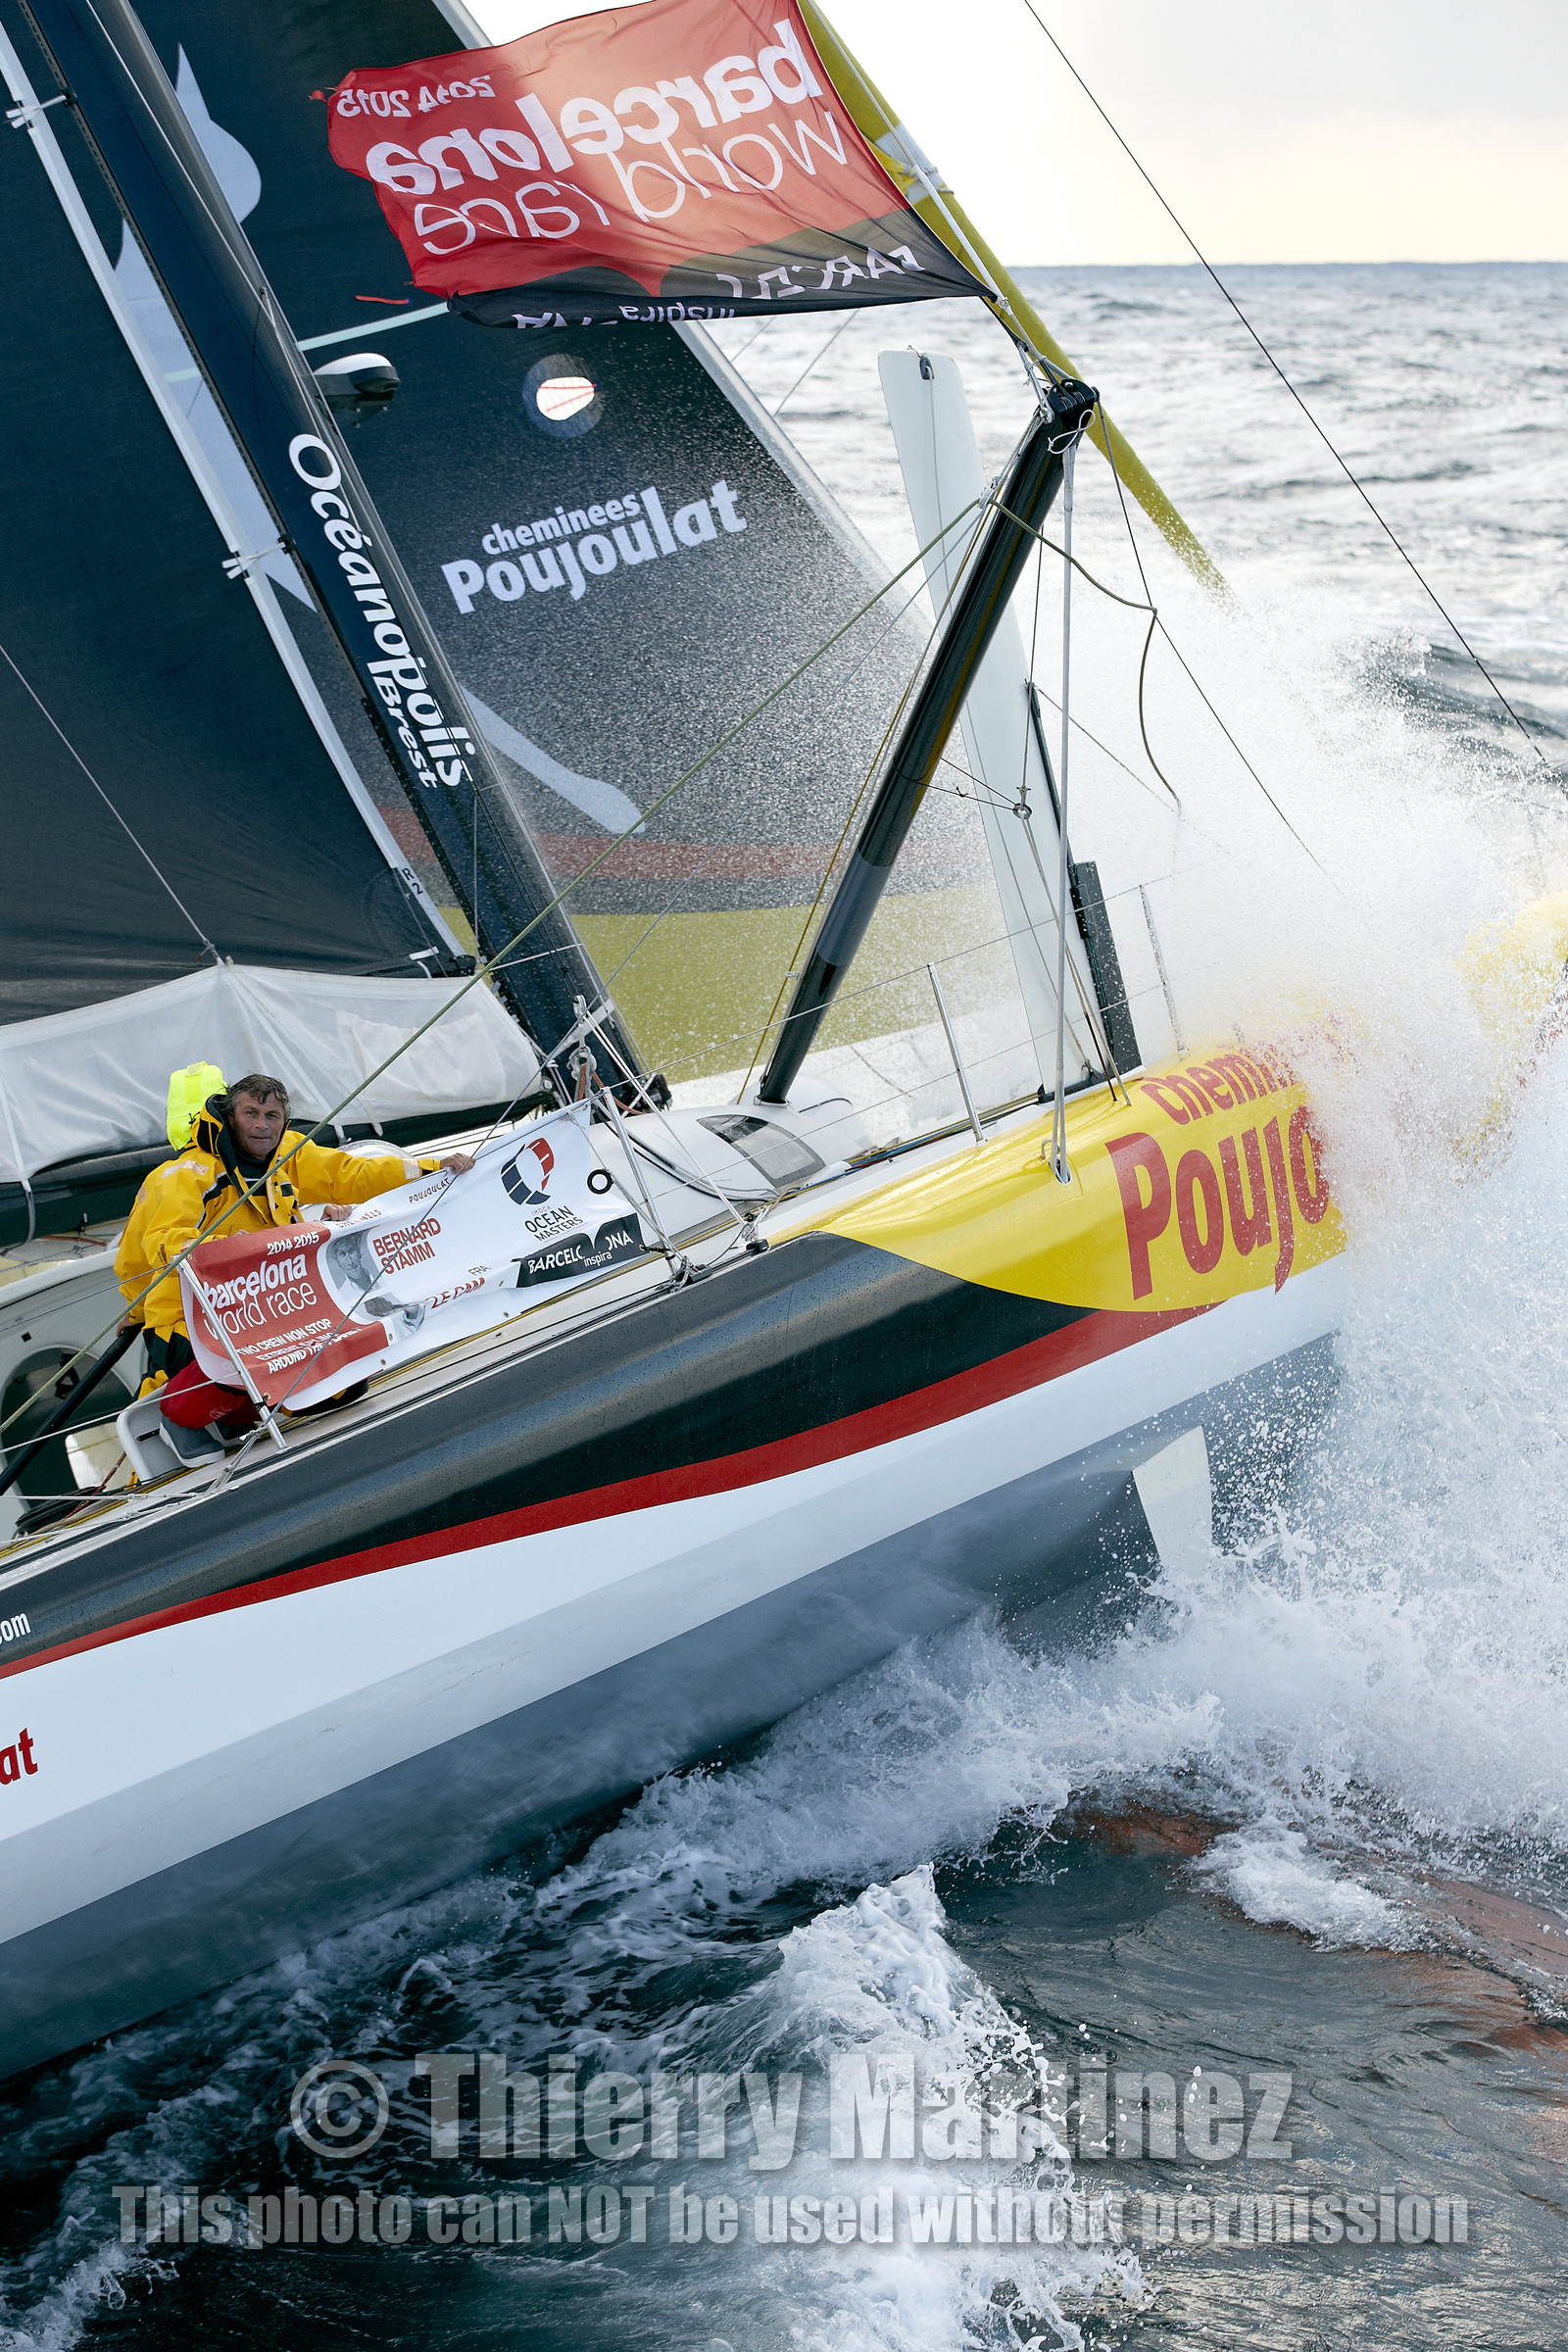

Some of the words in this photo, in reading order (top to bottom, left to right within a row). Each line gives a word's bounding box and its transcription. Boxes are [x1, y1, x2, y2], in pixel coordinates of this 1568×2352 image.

[482, 494, 641, 555] cheminees
[441, 480, 748, 614] Poujoulat
[372, 674, 438, 789] Brest
[409, 1178, 450, 1204] POUJOULAT
[524, 1205, 574, 1233] OCEAN
[534, 1216, 584, 1242] MASTERS
[267, 1242, 293, 1256] 2014
[294, 1231, 320, 1250] 2015
[372, 1217, 442, 1257] BERNARD
[381, 1241, 436, 1275] STAMM
[583, 1250, 612, 1268] inspira
[202, 1254, 308, 1311] barcelona
[267, 1282, 318, 1319] race
[258, 1335, 287, 1351] CREW
[285, 1327, 310, 1344] NON
[305, 1318, 332, 1336] STOP
[267, 1349, 307, 1374] AROUND
